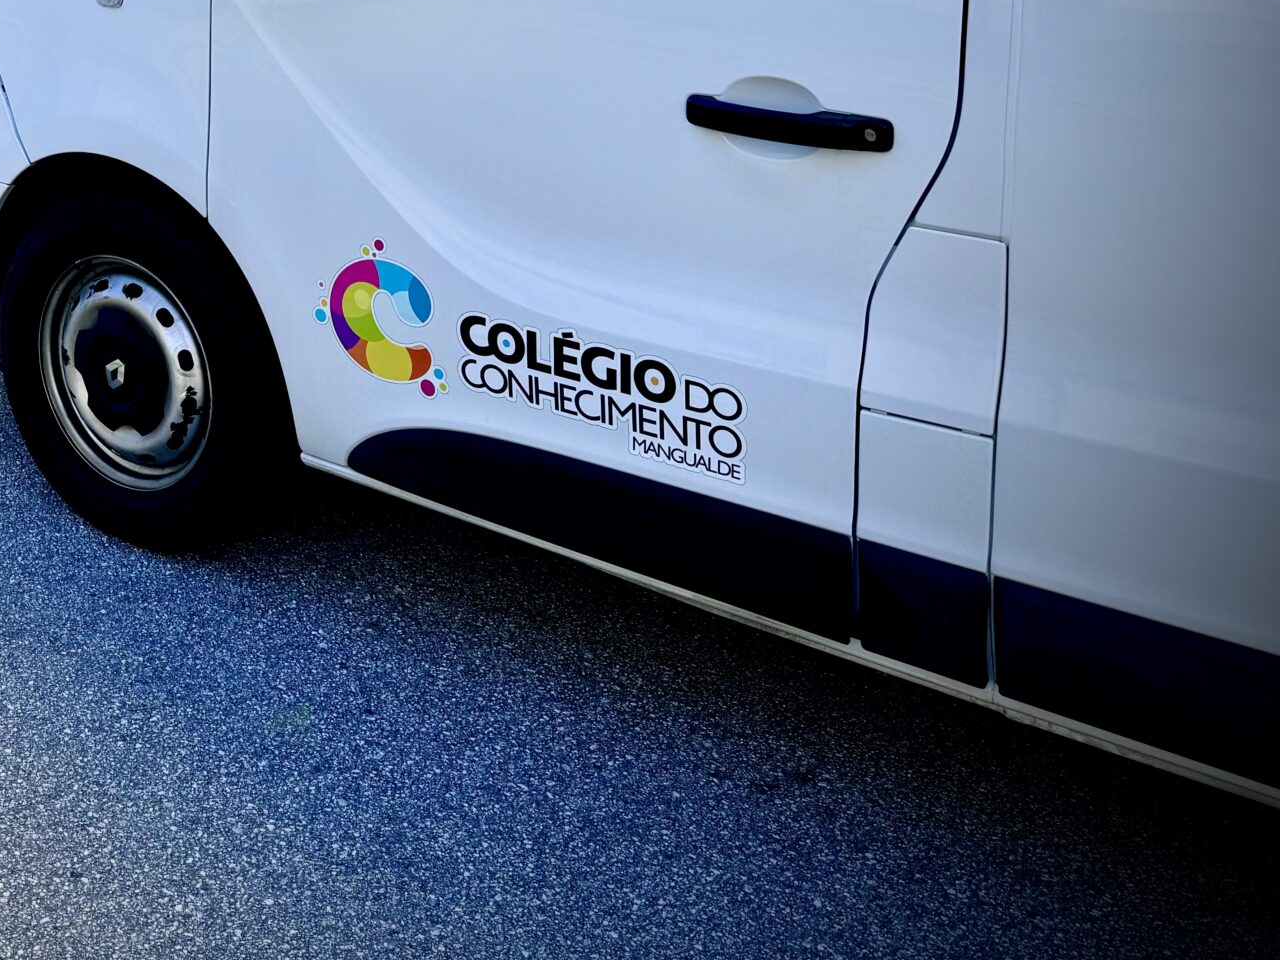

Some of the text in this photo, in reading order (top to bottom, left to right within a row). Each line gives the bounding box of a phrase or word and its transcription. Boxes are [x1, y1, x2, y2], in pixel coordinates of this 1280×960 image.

[459, 315, 743, 421] COLÉGIO DO
[461, 358, 743, 458] CONHECIMENTO
[633, 438, 741, 480] MANGUALDE
